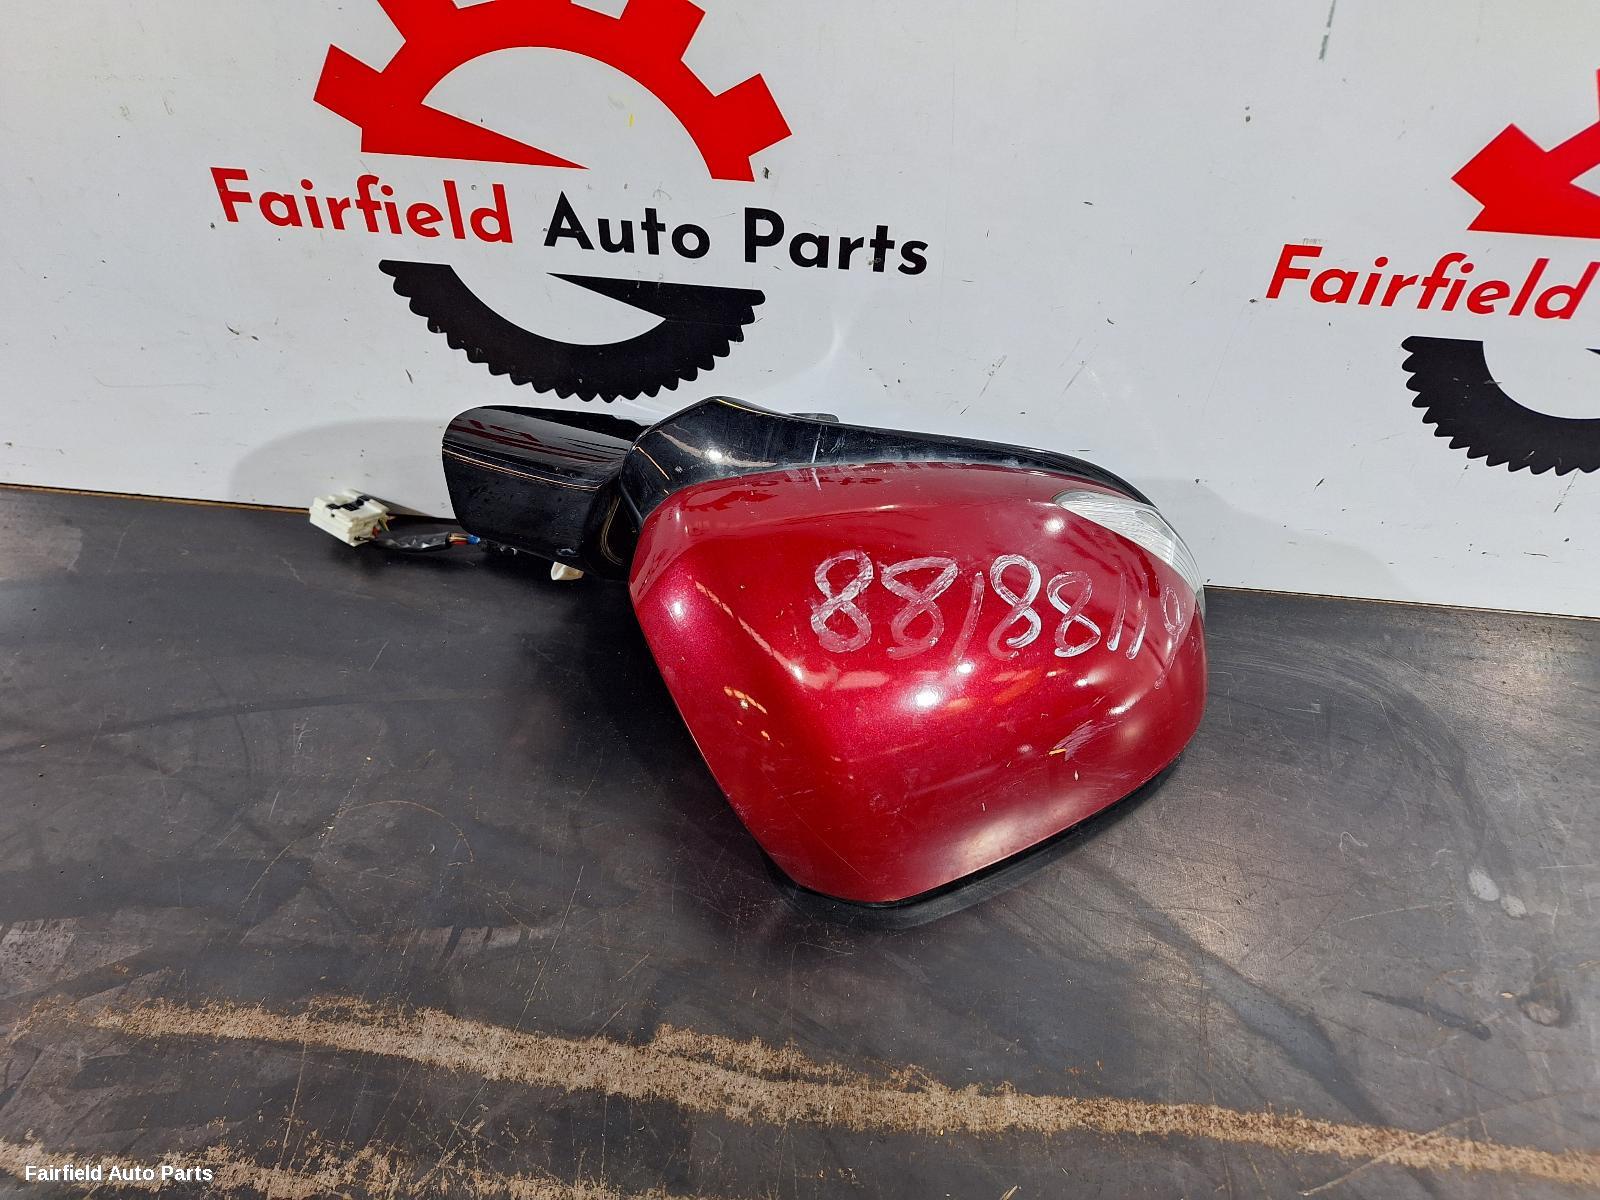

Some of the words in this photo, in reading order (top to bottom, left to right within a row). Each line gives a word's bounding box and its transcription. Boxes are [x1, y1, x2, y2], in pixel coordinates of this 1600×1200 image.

[210, 167, 513, 244] Fairfield
[543, 190, 711, 260] Auto
[744, 206, 929, 276] Parts
[1265, 243, 1600, 321] Fairfield
